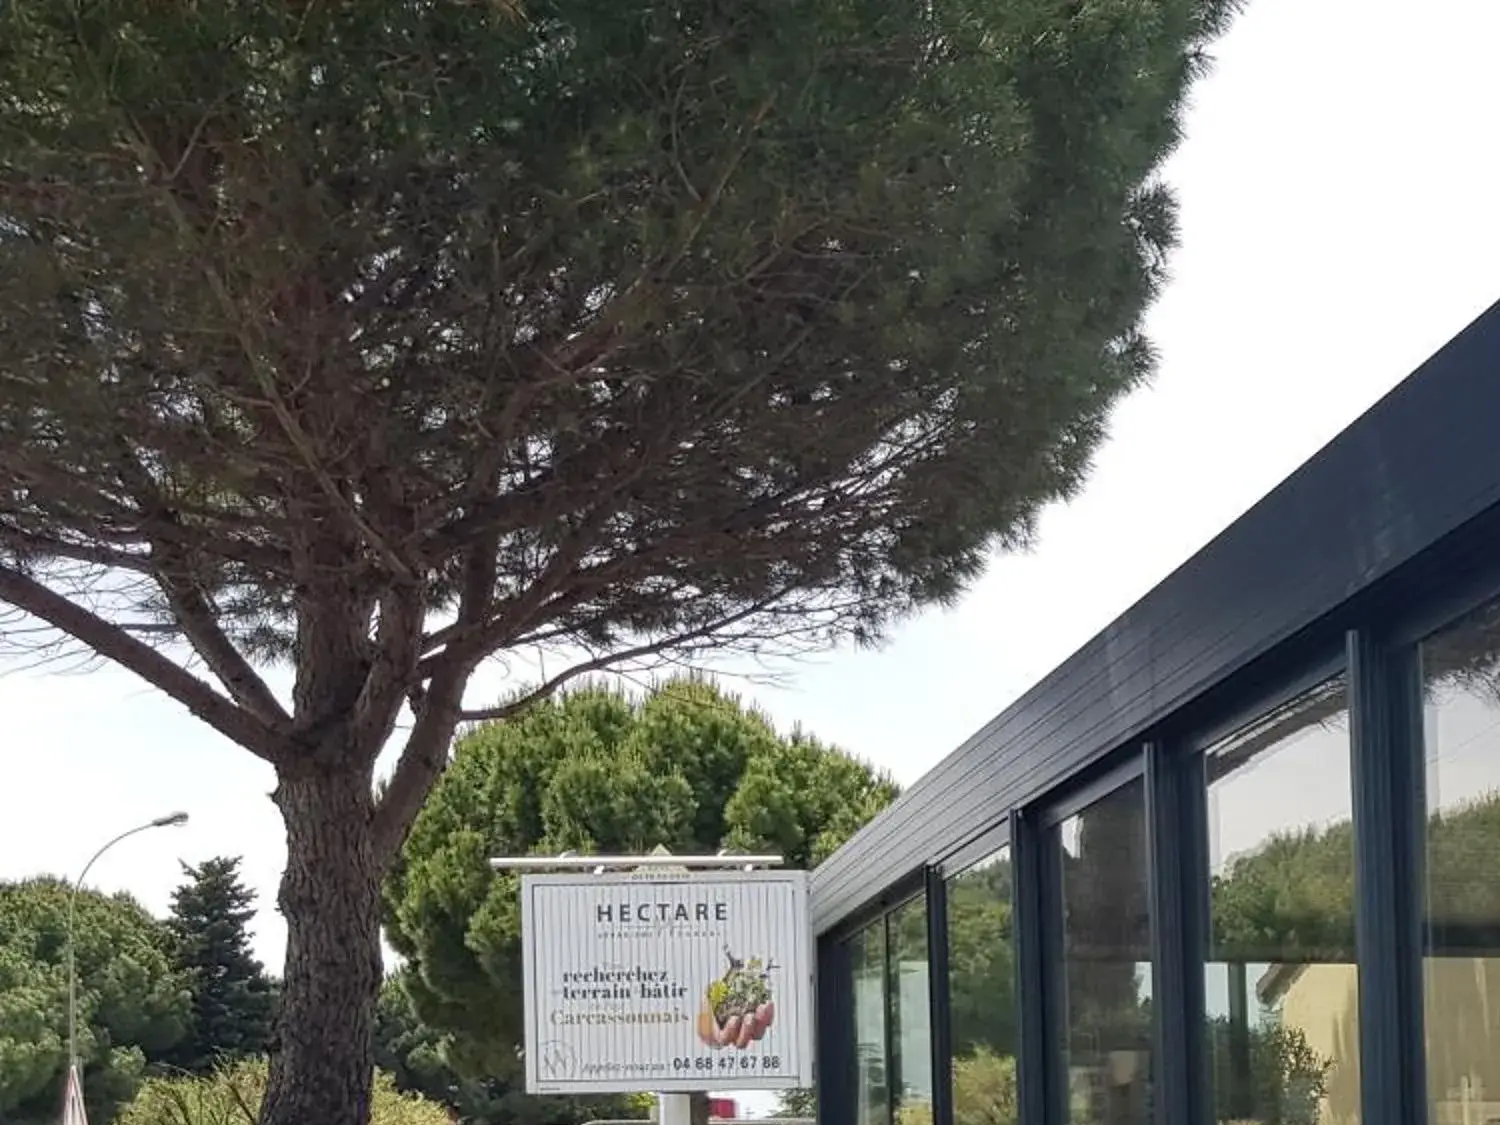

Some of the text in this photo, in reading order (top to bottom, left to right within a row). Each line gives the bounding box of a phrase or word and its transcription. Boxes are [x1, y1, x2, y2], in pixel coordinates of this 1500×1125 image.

[597, 903, 728, 922] HECTARE
[563, 966, 668, 982] recherchez
[563, 983, 631, 999] terrain
[673, 1057, 691, 1071] 04
[718, 1056, 735, 1069] 47
[740, 1056, 757, 1069] 67
